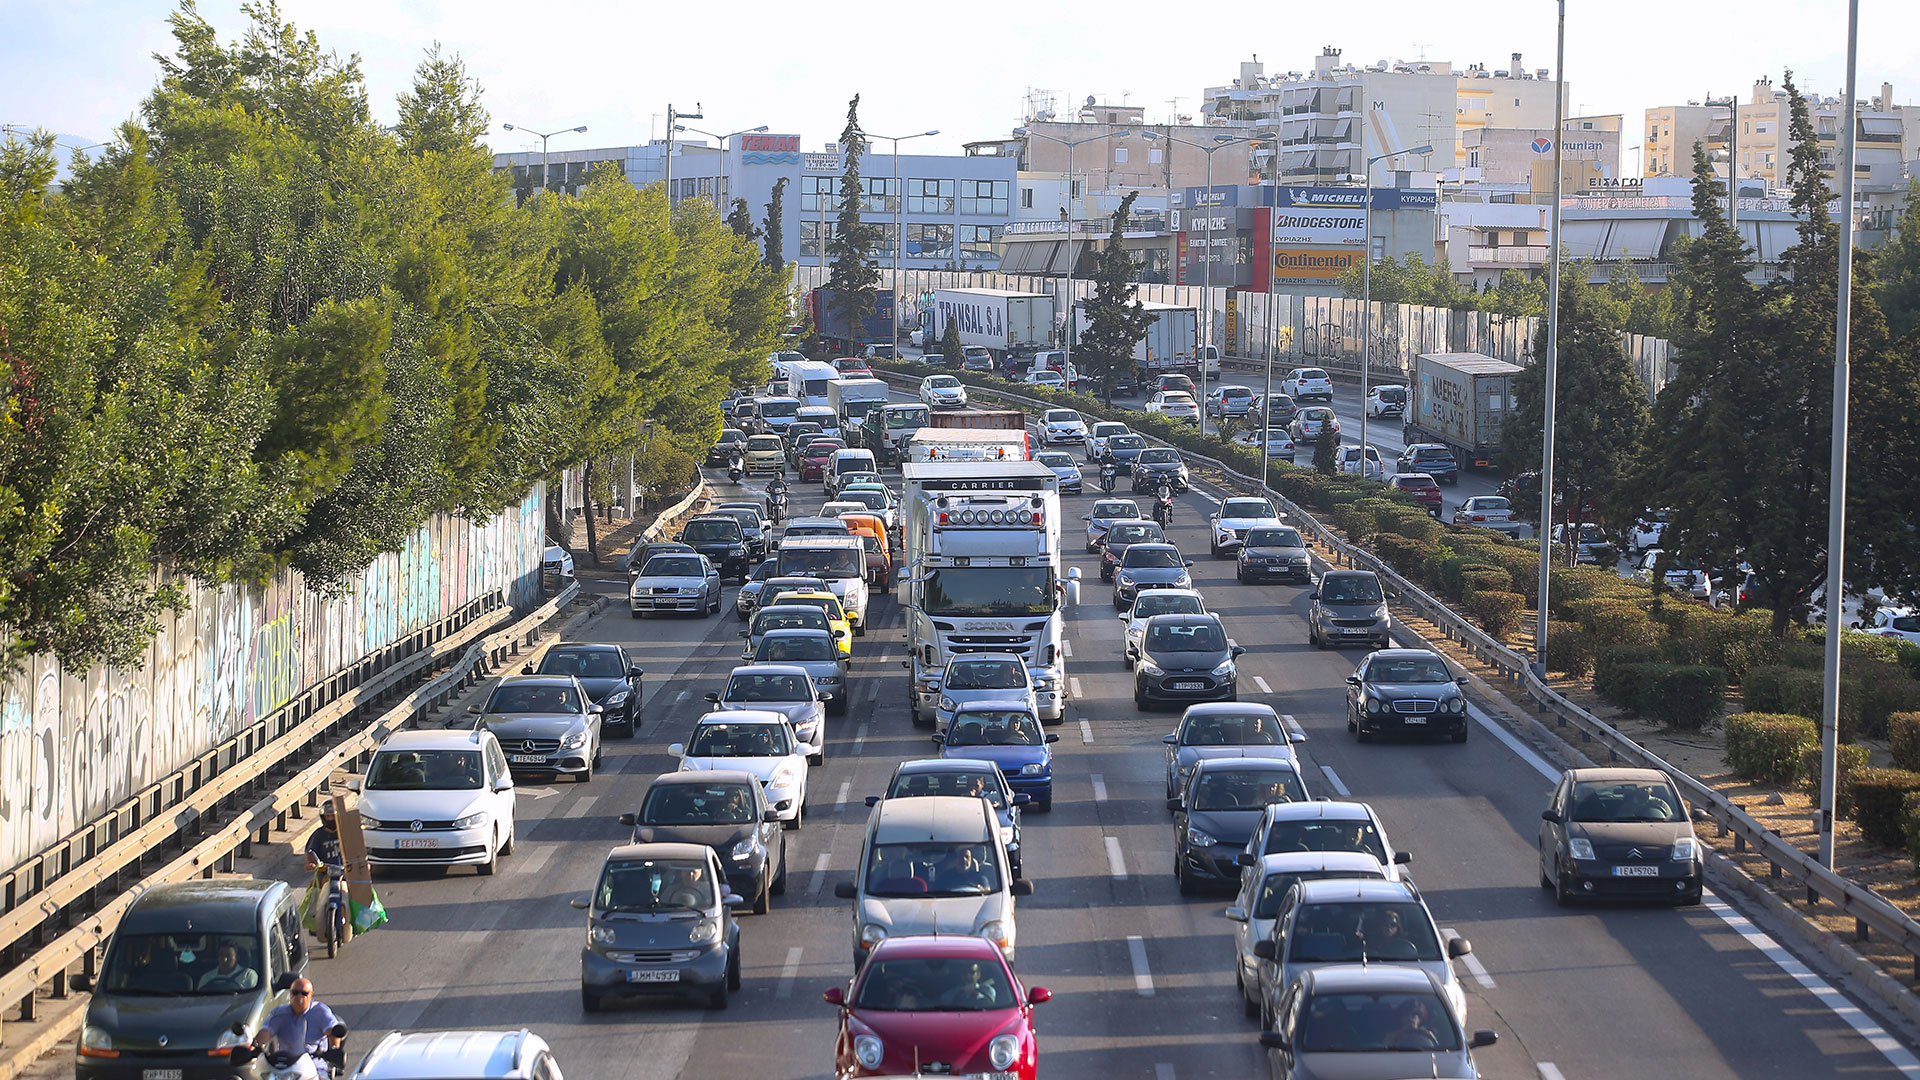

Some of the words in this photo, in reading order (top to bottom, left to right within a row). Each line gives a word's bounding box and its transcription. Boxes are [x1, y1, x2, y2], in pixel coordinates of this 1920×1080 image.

[741, 136, 800, 152] TEMAK
[1553, 140, 1602, 150] hunlan
[1311, 194, 1374, 203] MICHELIN
[1401, 195, 1435, 203] ΚΥΡΙΑΖΗΣ
[1277, 215, 1365, 229] BRIDGESTONE
[1274, 252, 1352, 269] Continental
[951, 482, 1014, 490] CARRIER
